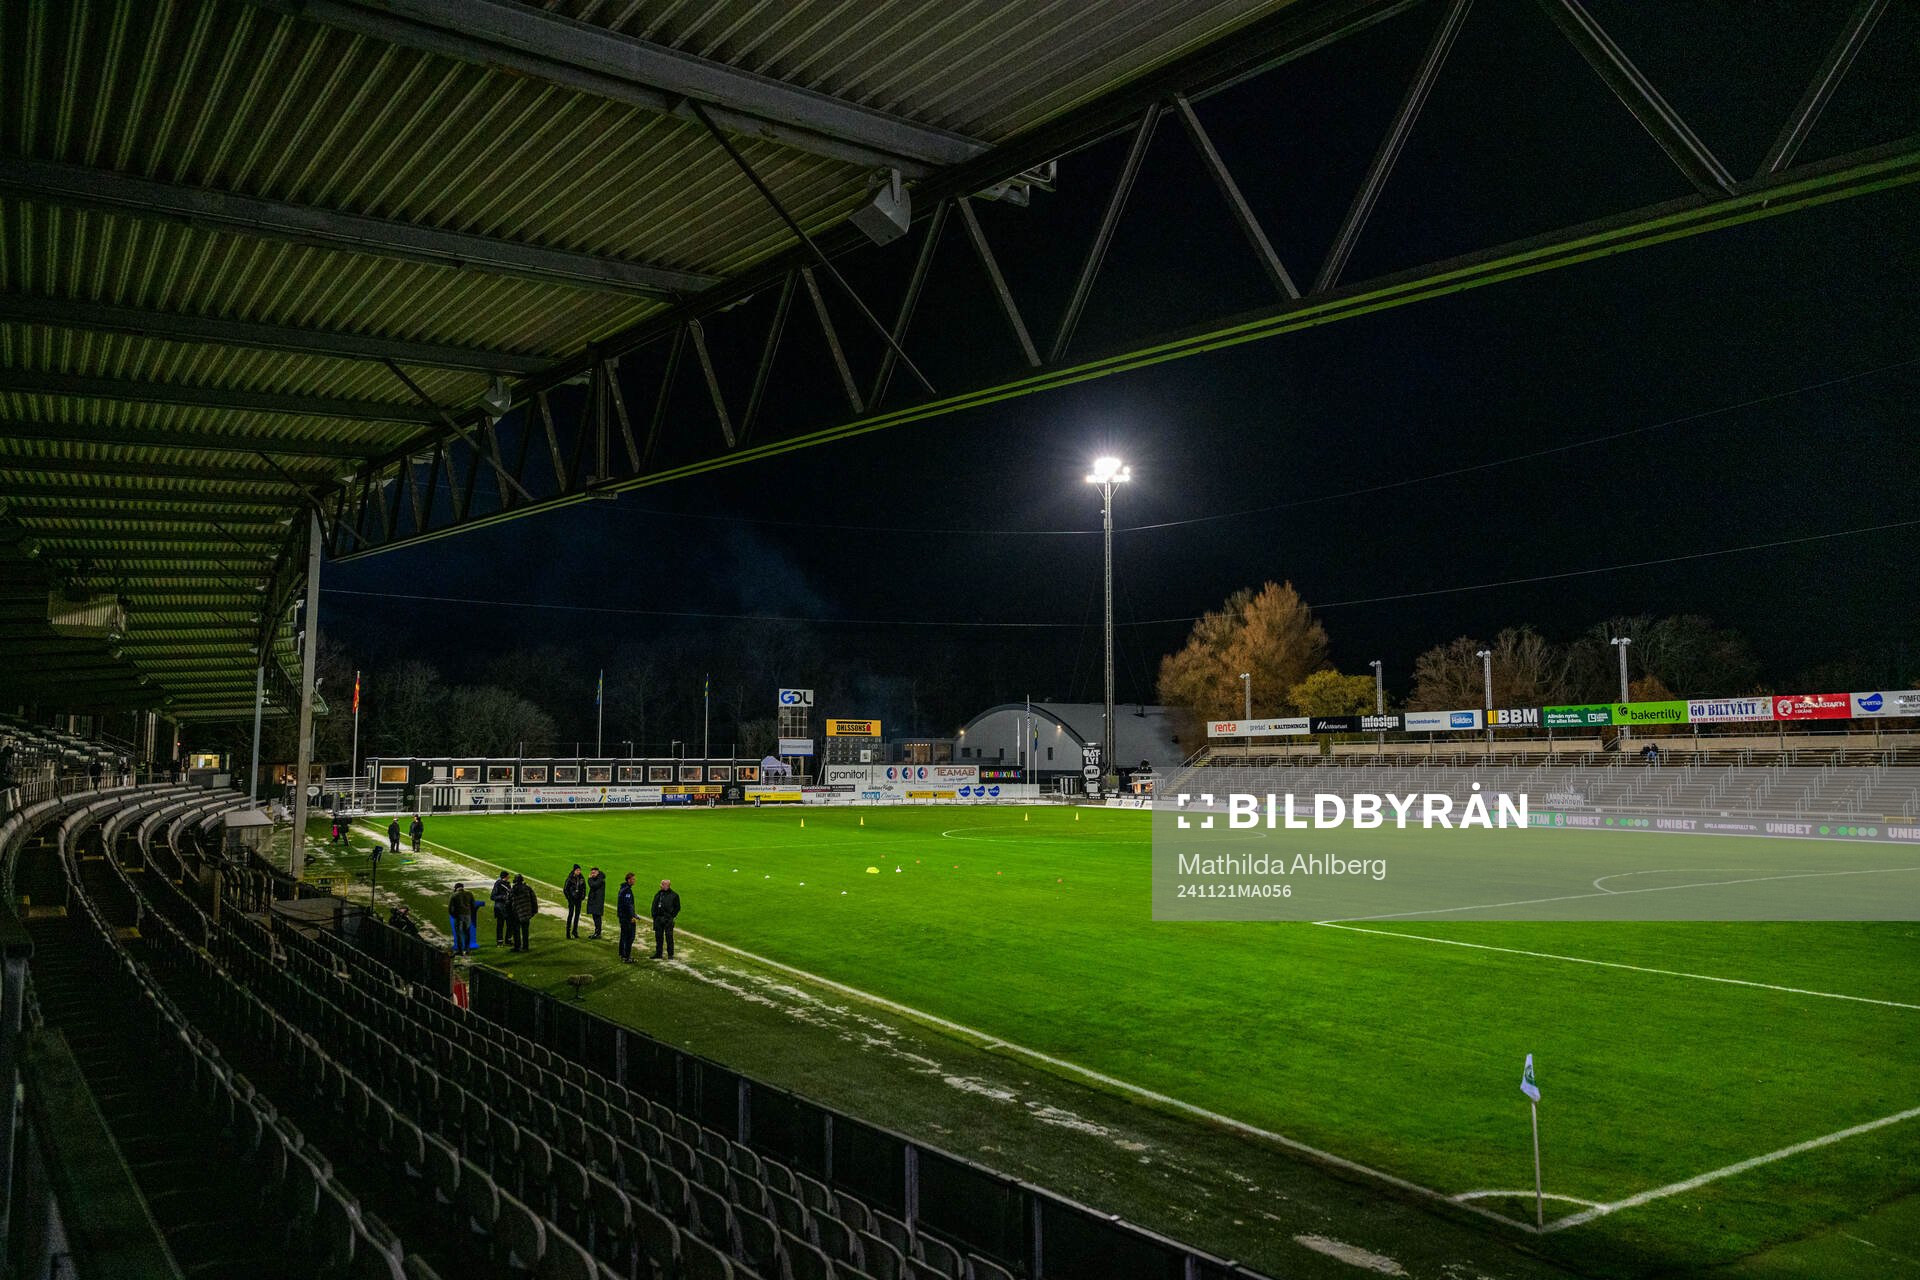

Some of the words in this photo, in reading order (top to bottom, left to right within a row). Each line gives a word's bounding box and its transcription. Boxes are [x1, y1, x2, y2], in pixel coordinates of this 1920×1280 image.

[781, 691, 812, 705] GDL
[1691, 705, 1705, 716] GO
[1708, 701, 1757, 716] BILTVÄTT
[1498, 708, 1538, 724] BBM
[1631, 709, 1682, 721] bakertilly
[1215, 723, 1236, 732] renta
[1361, 715, 1399, 728] infosign
[837, 724, 866, 732] OHLSSONS
[830, 769, 865, 781] granitor
[1566, 815, 1600, 826] UNIBET
[1656, 818, 1696, 830] UNIBET
[1766, 822, 1812, 835] UNIBET
